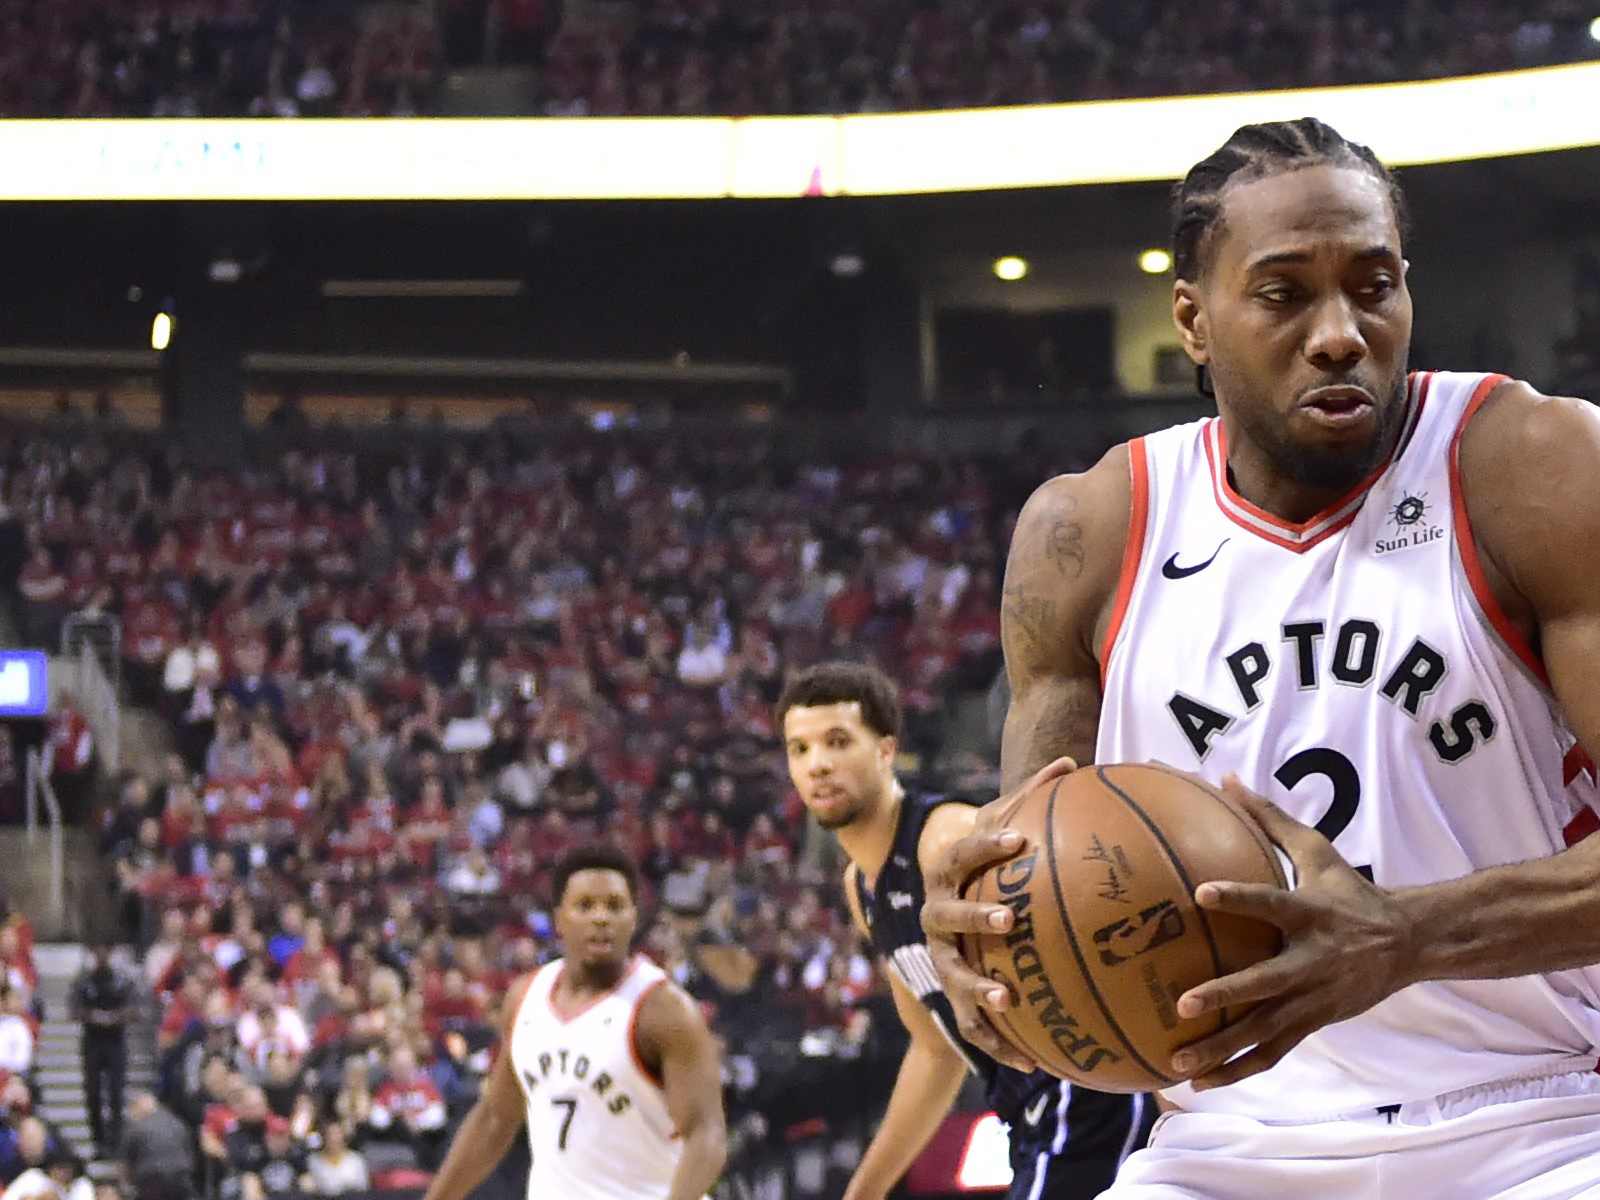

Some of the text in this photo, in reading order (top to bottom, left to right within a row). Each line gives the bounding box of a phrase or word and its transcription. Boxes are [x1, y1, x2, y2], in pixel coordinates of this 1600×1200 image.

[1375, 525, 1444, 554] Sun Life
[1164, 617, 1500, 766] APTORS
[522, 1049, 632, 1116] APTORS
[551, 1096, 577, 1151] 7
